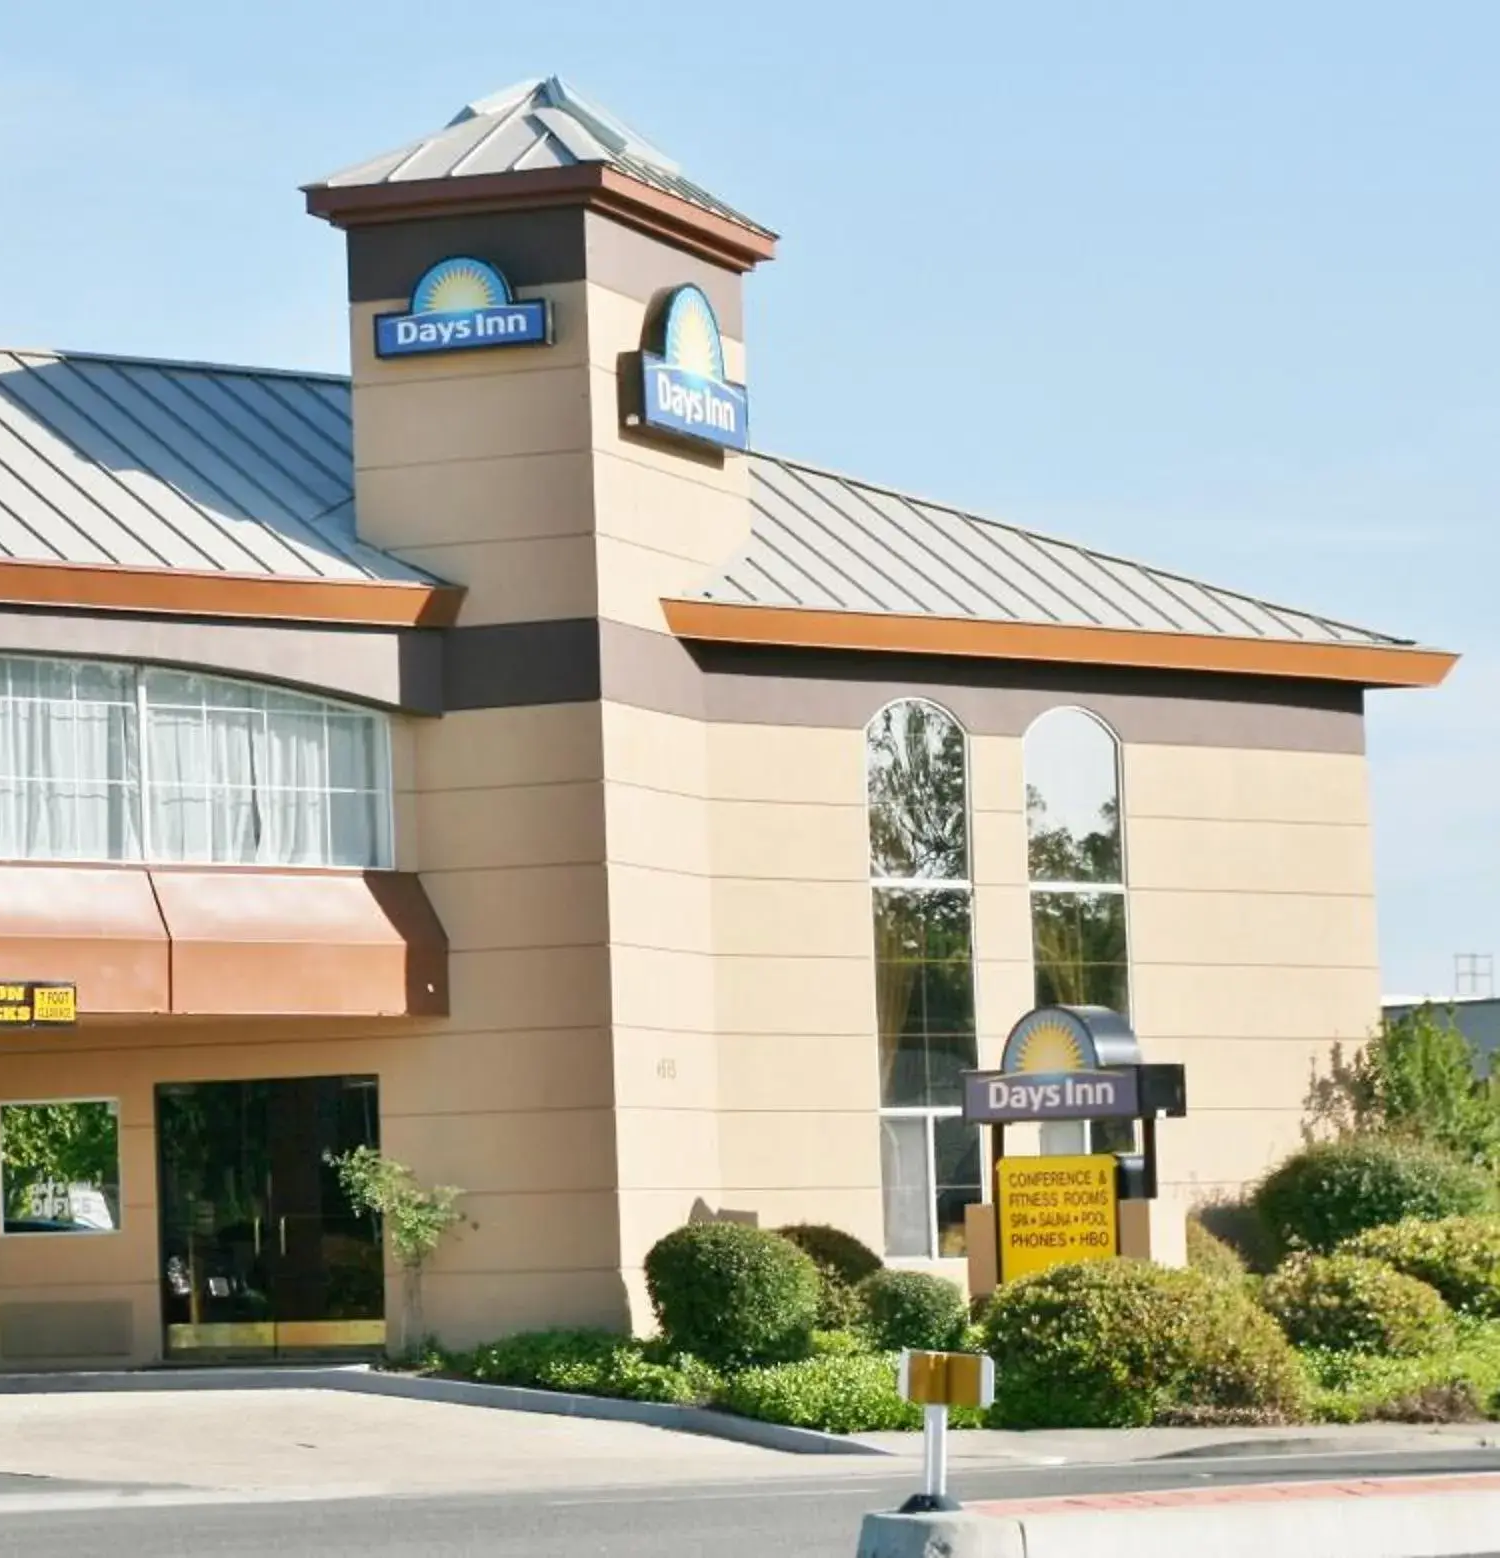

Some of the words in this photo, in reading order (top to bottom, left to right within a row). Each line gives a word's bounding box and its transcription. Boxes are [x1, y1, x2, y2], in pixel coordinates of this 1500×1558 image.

[397, 319, 471, 346] Days
[476, 312, 528, 337] Inn
[657, 371, 704, 426] Days
[704, 389, 735, 432] Inn
[989, 1081, 1061, 1112] Days
[1065, 1078, 1115, 1107] Inn
[1009, 1170, 1092, 1187] CONFERENCE
[1098, 1170, 1107, 1185] &
[1009, 1192, 1059, 1208] FITNESS
[1063, 1192, 1109, 1206] ROOMS
[1010, 1213, 1030, 1228] SPA
[1039, 1213, 1073, 1228] SAUNA
[1081, 1213, 1108, 1227] POOL
[1011, 1232, 1067, 1247] PHONES
[1079, 1232, 1110, 1247] HBO
